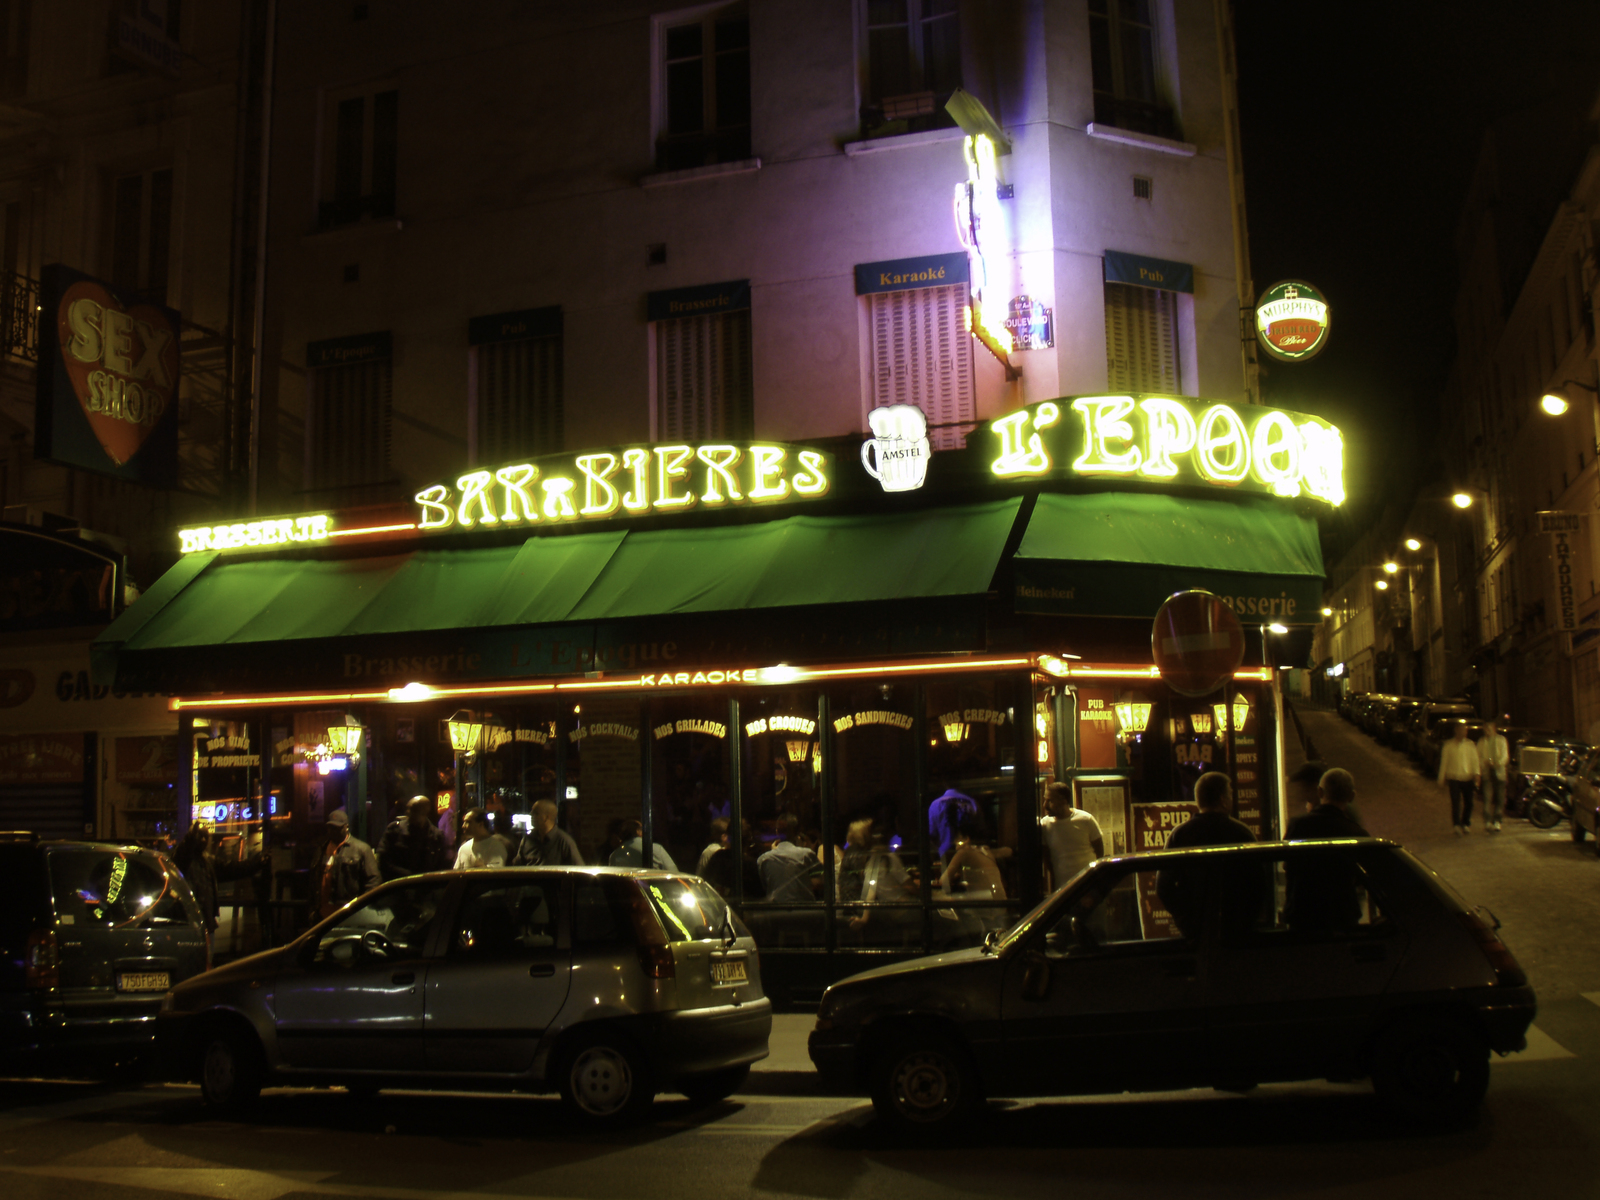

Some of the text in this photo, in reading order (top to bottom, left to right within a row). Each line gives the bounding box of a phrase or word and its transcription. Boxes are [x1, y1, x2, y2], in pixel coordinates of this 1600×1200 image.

[879, 265, 946, 286] Karaoké
[1139, 267, 1164, 283] Pub
[669, 293, 730, 313] Brasserie
[502, 321, 527, 336] Pub
[67, 298, 174, 389] SEX
[86, 369, 165, 427] SHOP
[882, 447, 922, 461] AMSTEL
[990, 396, 1346, 507] L'EPOQ
[415, 463, 541, 529] BAR
[576, 444, 827, 514] BIERES
[1016, 585, 1076, 599] Heineken
[343, 640, 678, 678] Brasserie L'Epoque
[641, 669, 757, 686] KARAOKE
[1088, 699, 1104, 709] PUB
[745, 716, 816, 738] NOS CROQUES
[833, 710, 914, 733] NOS SANDWICHES
[938, 708, 1006, 727] NOS CREPES
[514, 729, 548, 746] BIERES
[568, 722, 640, 744] NOS COCKTAILS
[653, 719, 728, 741] NOS GRILLADES
[206, 736, 250, 752] NOS VINS
[211, 754, 260, 768] PROPRIETE
